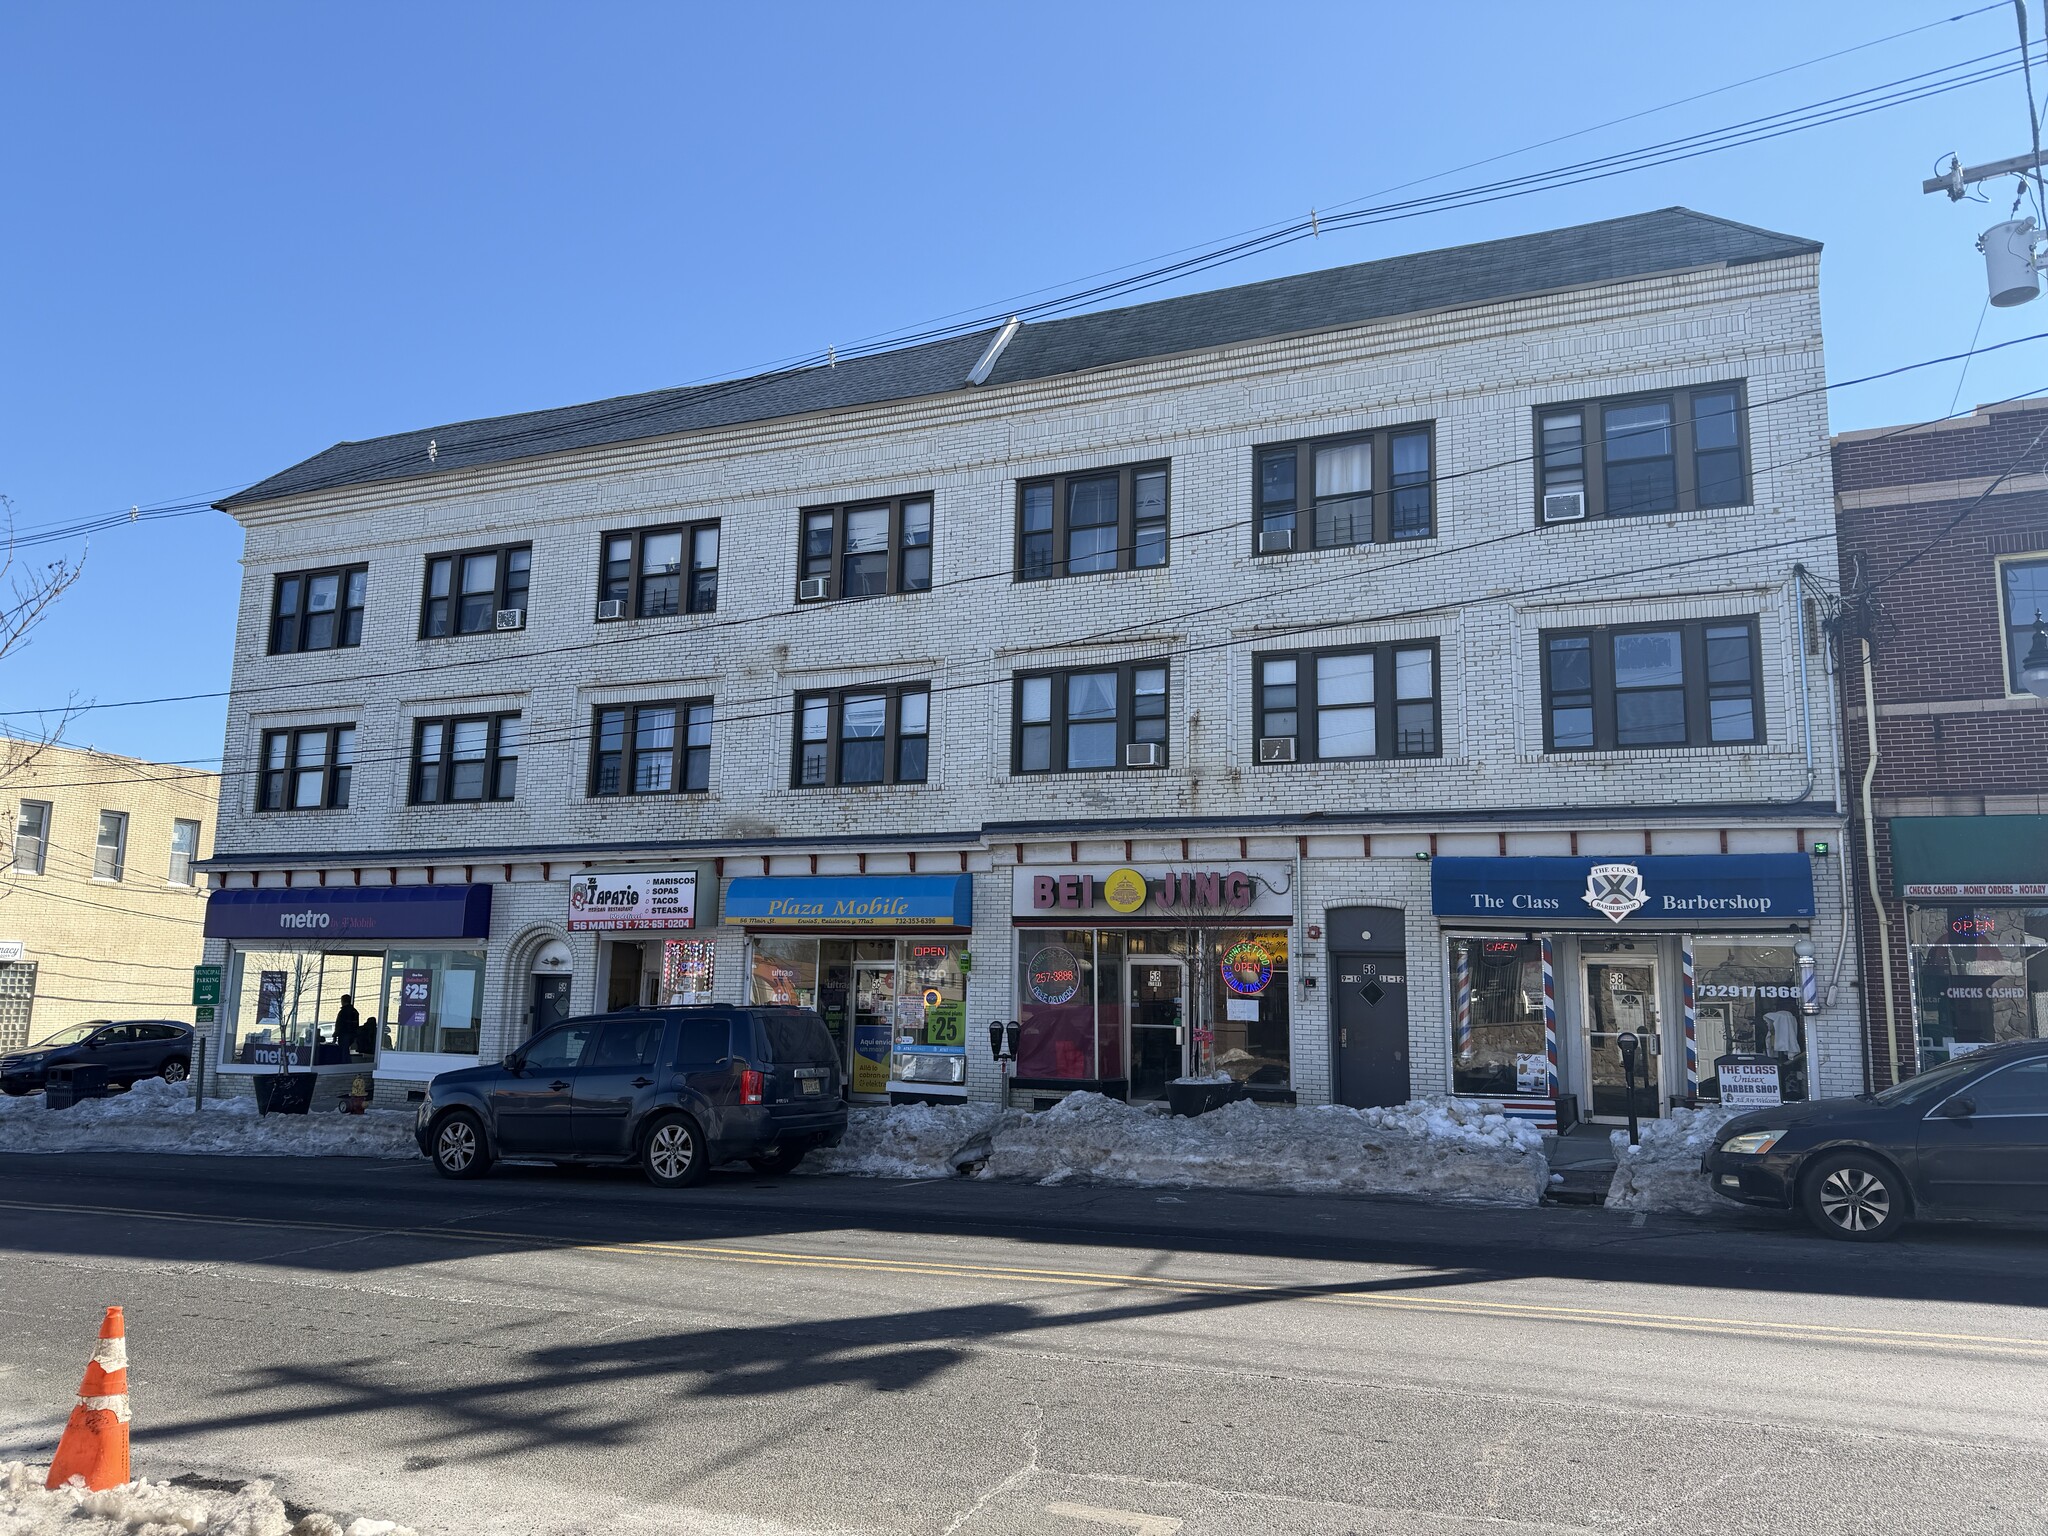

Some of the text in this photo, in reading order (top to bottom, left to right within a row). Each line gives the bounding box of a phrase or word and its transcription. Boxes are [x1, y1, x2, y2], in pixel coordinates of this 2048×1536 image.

[1611, 866, 1636, 874] CLASS
[652, 877, 695, 885] MARISCOS
[1033, 870, 1251, 909] BEI JING
[1908, 885, 1932, 895] CHECKS
[1933, 885, 1958, 895] CASHED
[1963, 885, 1986, 895] MONEY
[1988, 885, 2014, 894] ORDERS
[2019, 885, 2046, 894] NOTARY
[768, 897, 909, 915] Plaza Mobile
[1470, 893, 1559, 909] The Class
[1596, 902, 1637, 911] BARBERSHOP
[1662, 894, 1772, 913] Barbershop
[651, 906, 689, 914] STEASKS
[280, 909, 330, 929] metro
[573, 921, 588, 930] 56
[588, 921, 615, 930] MAIN
[634, 919, 690, 929] 732-651-0204
[1952, 919, 1995, 932] OPEN
[914, 946, 946, 957] OPEN
[1486, 942, 1518, 952] OPEN
[1252, 945, 1270, 966] FOOD
[1234, 962, 1260, 973] OPEN
[1363, 964, 1375, 974] 58
[1035, 970, 1073, 984] 257-3888
[1150, 971, 1160, 981] 58
[1341, 975, 1361, 983] 9-10
[1610, 973, 1623, 985] 58
[405, 983, 428, 1000] $25
[1697, 984, 1801, 999] 7329171368
[1946, 987, 2025, 999] CHECKS CASHED
[932, 1017, 957, 1040] $25
[1720, 1065, 1776, 1075] THE CLASS
[1732, 1075, 1766, 1085] Unisex
[1721, 1084, 1778, 1094] BARBER SHOP
